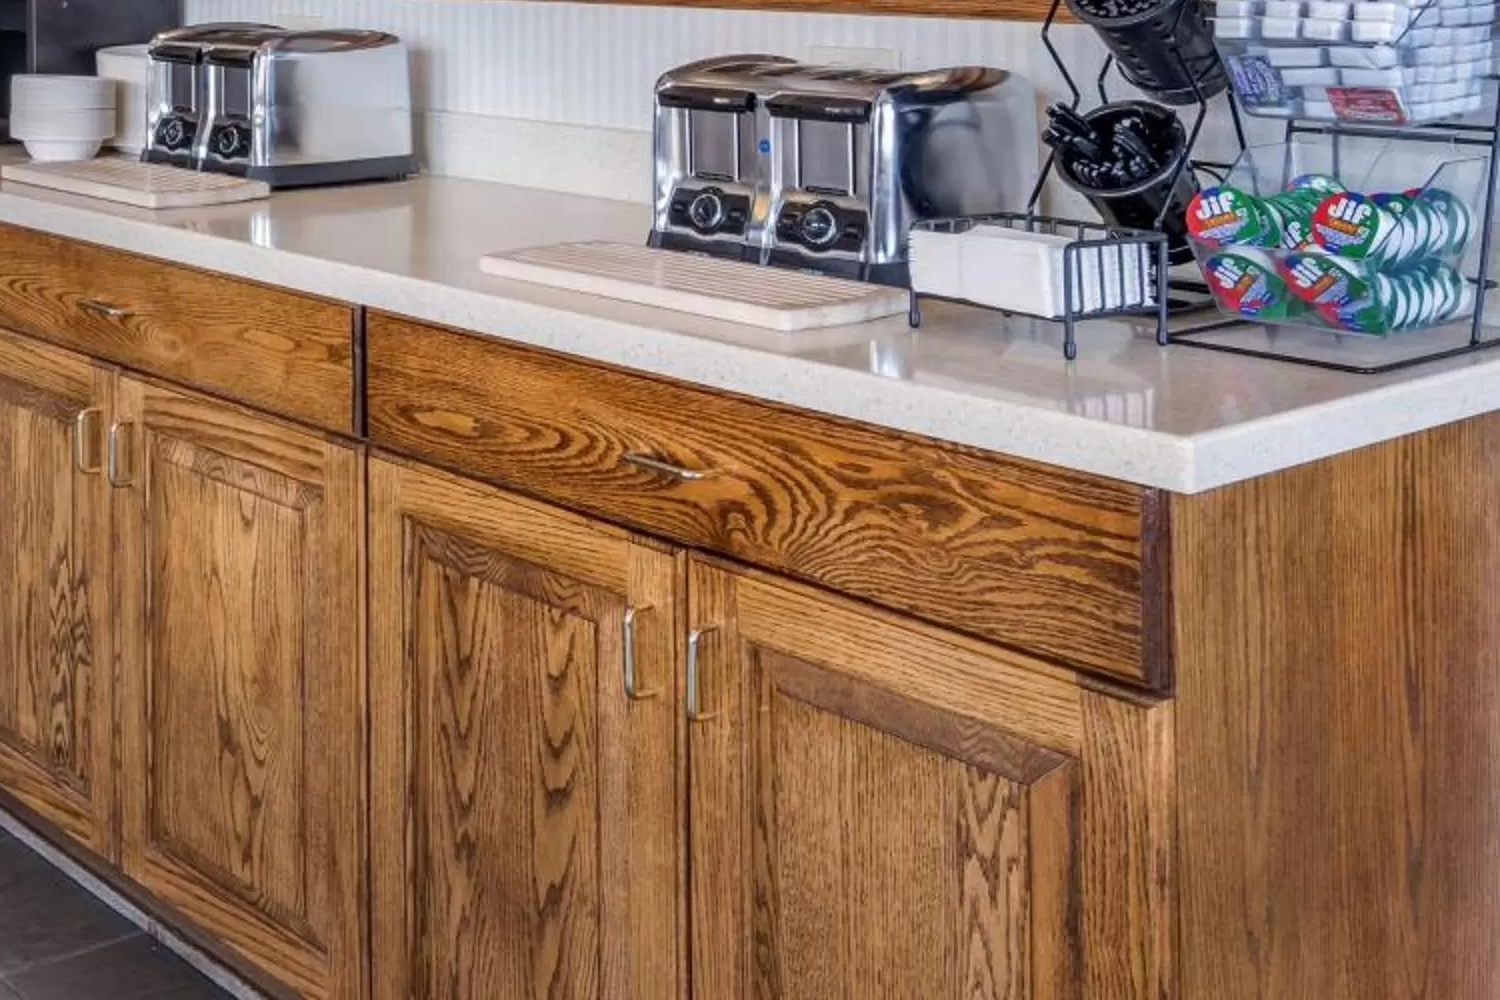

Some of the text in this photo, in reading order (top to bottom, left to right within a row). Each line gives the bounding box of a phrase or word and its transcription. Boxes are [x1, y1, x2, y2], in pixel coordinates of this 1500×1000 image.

[1196, 191, 1235, 219] Jif
[1328, 198, 1372, 224] Jif
[1214, 258, 1244, 289] Jif
[1291, 257, 1324, 288] Jif
